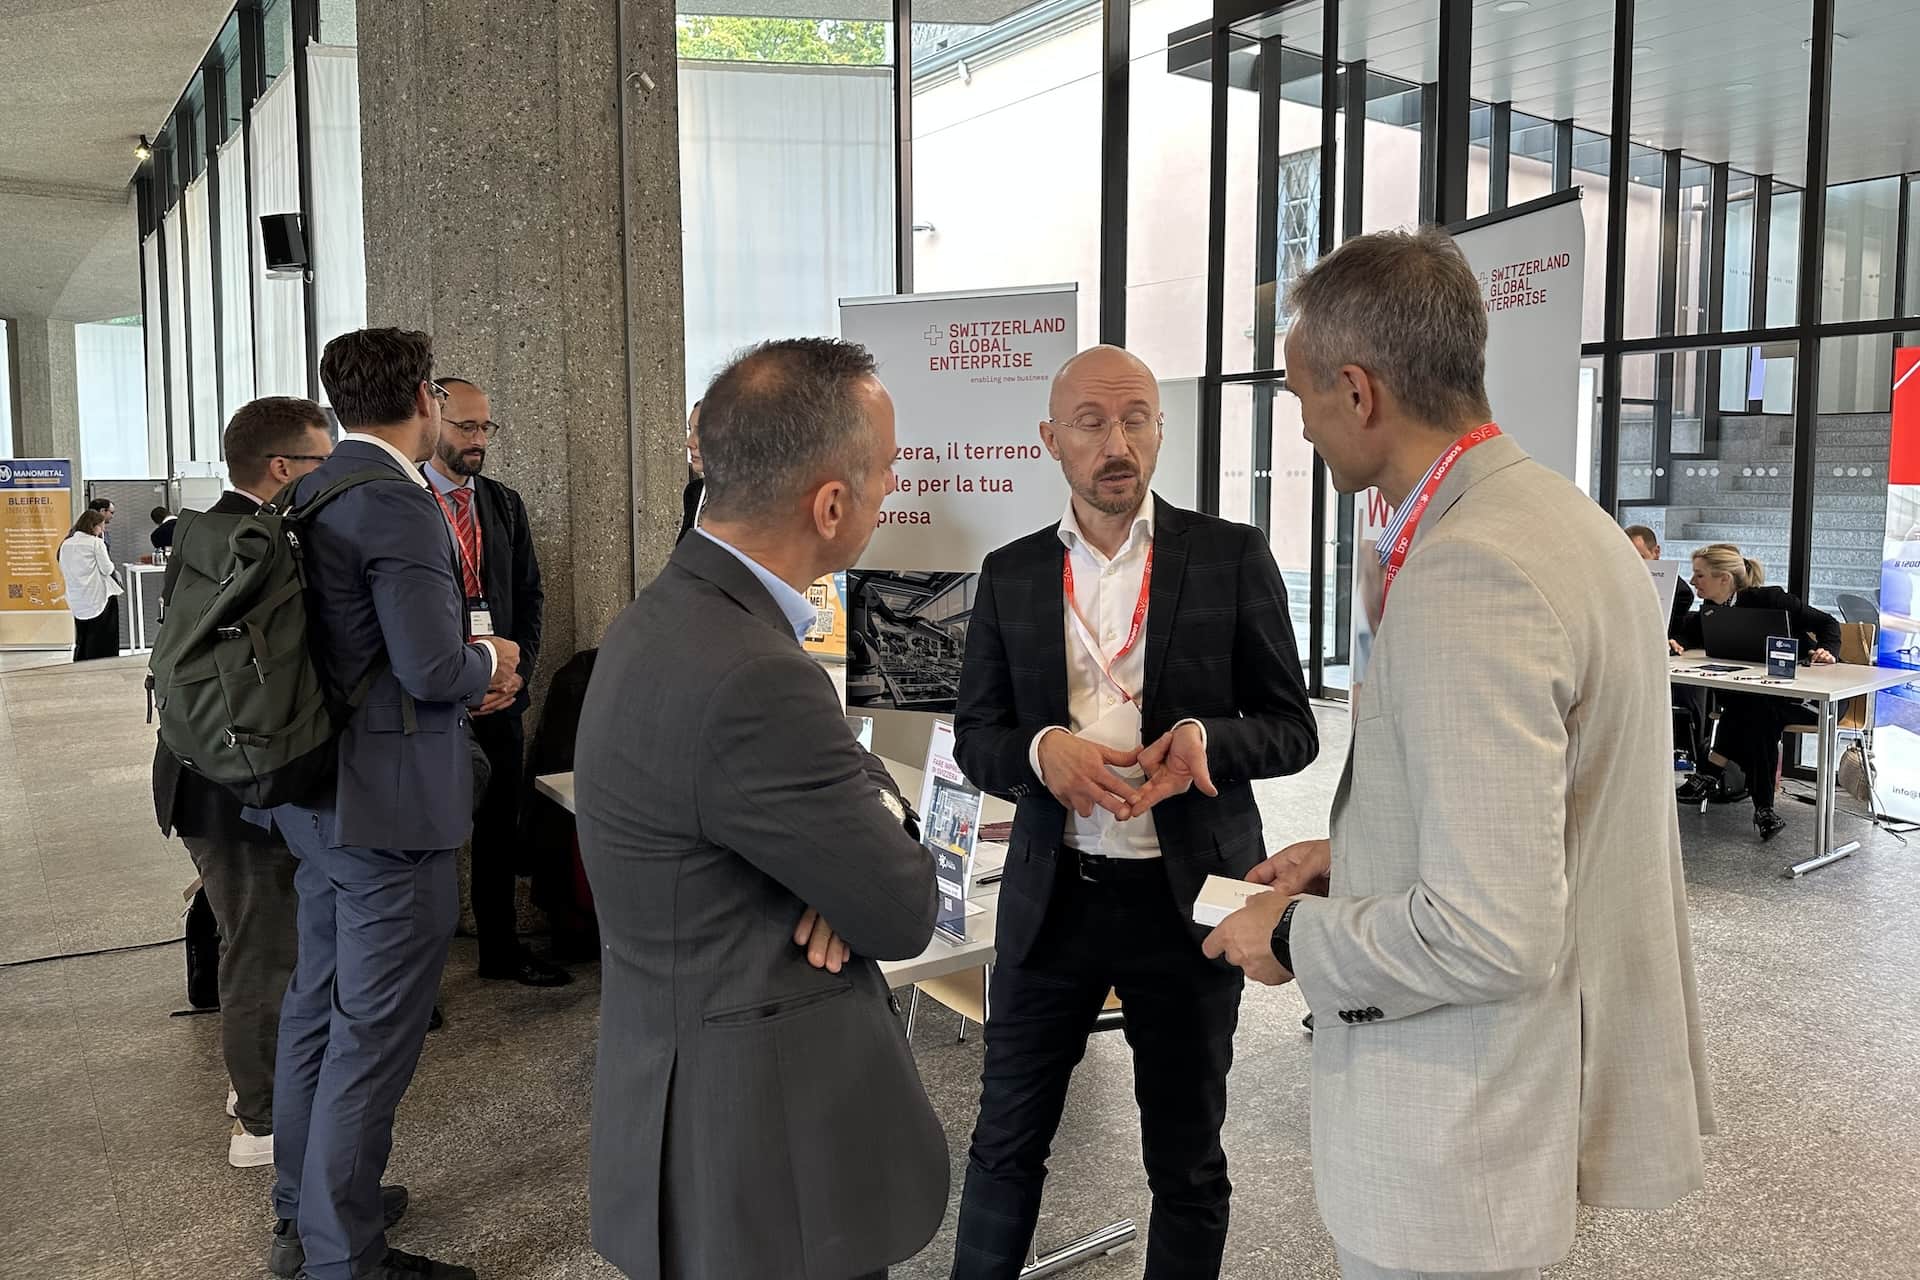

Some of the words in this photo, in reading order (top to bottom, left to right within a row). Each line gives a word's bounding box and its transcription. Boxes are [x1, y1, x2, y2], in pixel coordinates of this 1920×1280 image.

[1491, 253, 1569, 282] SWITZERLAND
[1490, 277, 1532, 297] GLOBAL
[949, 318, 1065, 338] SWITZERLAND
[949, 338, 1012, 354] GLOBAL
[930, 353, 1033, 371] ENTERPRISE
[970, 375, 1002, 384] enabling
[947, 442, 959, 460] il
[965, 443, 1041, 460] terreno
[13, 469, 65, 477] MANOMETAL
[918, 479, 950, 496] per
[956, 475, 973, 492] la
[979, 477, 1014, 492] tua
